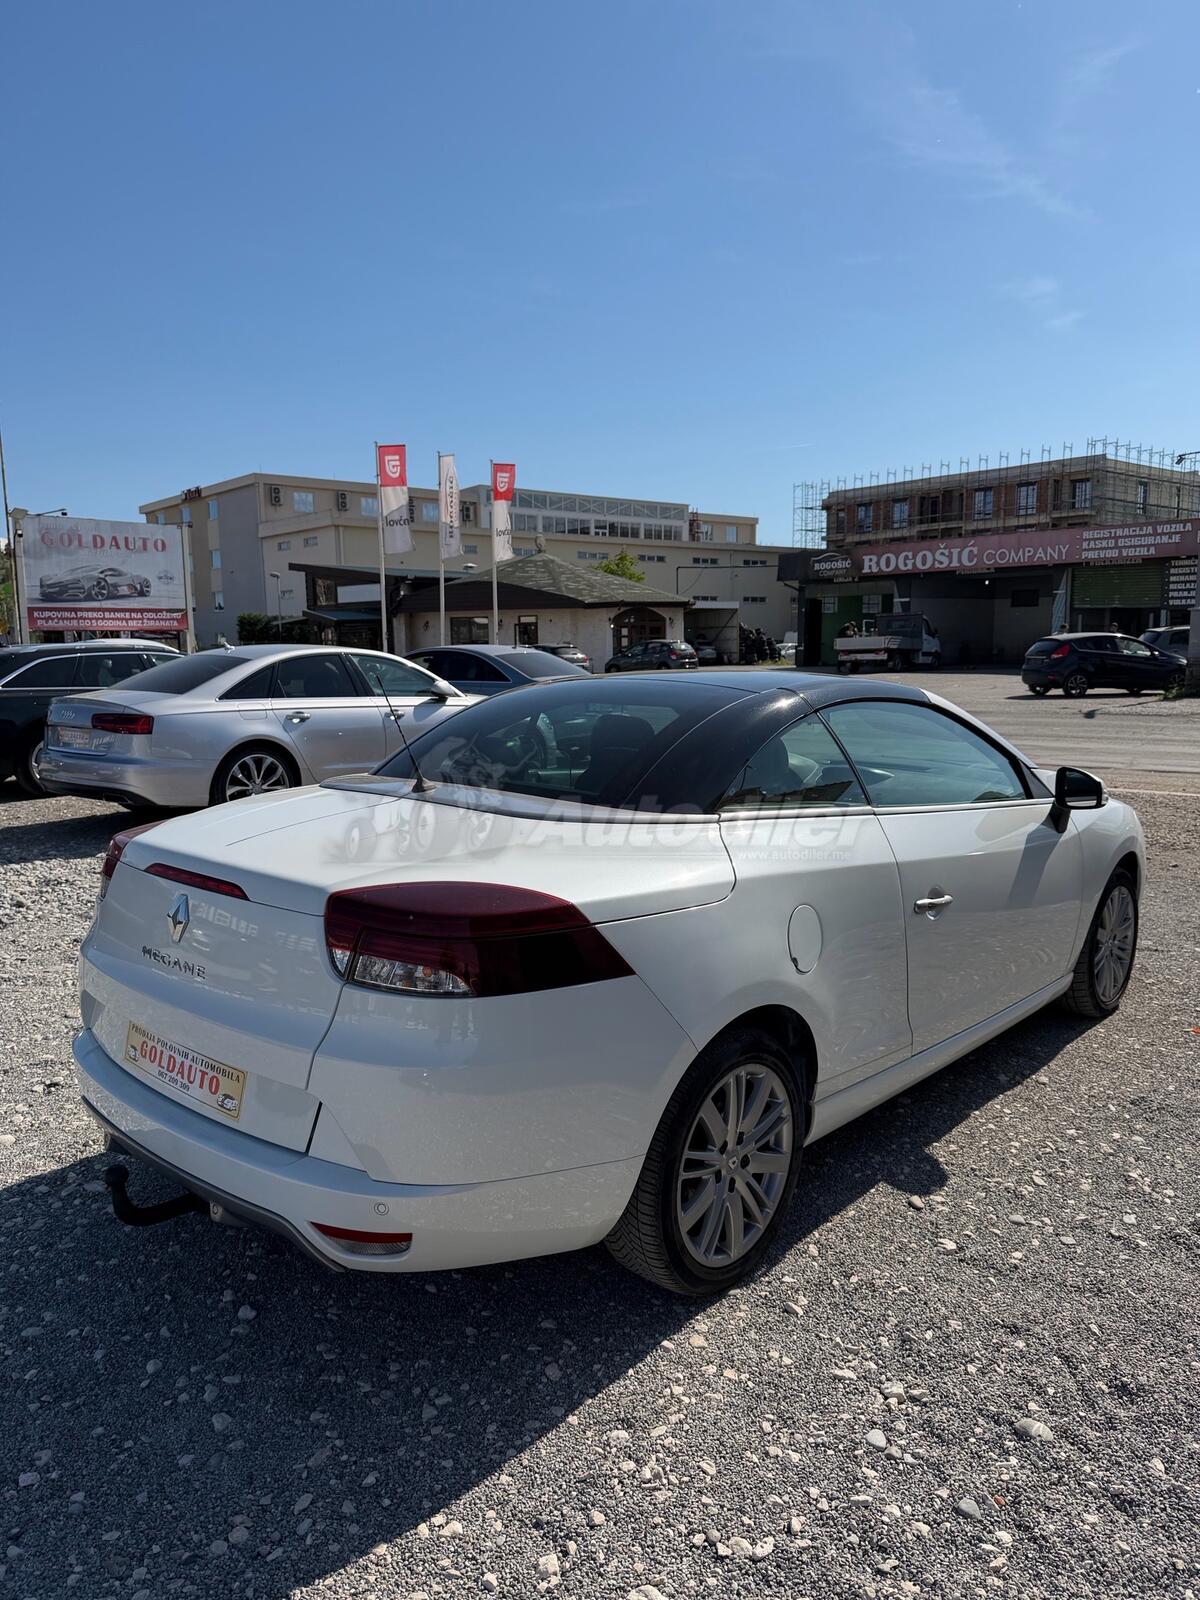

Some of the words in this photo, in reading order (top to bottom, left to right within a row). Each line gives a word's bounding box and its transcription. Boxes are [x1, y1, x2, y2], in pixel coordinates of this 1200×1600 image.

[1082, 525, 1153, 540] REGISTRACIJA
[1156, 522, 1192, 533] VOZILA
[41, 531, 167, 553] GOLDAUTO
[1082, 539, 1115, 550] KASKO
[1118, 534, 1182, 547] OSIGURANJE
[862, 540, 978, 574] ROGOŠIĆ
[983, 544, 1070, 565] COMPANY
[1081, 549, 1119, 560] PREVOD
[1122, 546, 1156, 557] VOZILA
[77, 611, 103, 619] PREKO
[97, 619, 127, 627] GODINA
[141, 945, 206, 979] MEGANE
[131, 1023, 156, 1043] PRODAJA
[156, 1037, 190, 1060] POLOVNIH
[191, 1055, 240, 1083] AUTOMOBILA
[140, 1040, 221, 1095] GOLDAUTO
